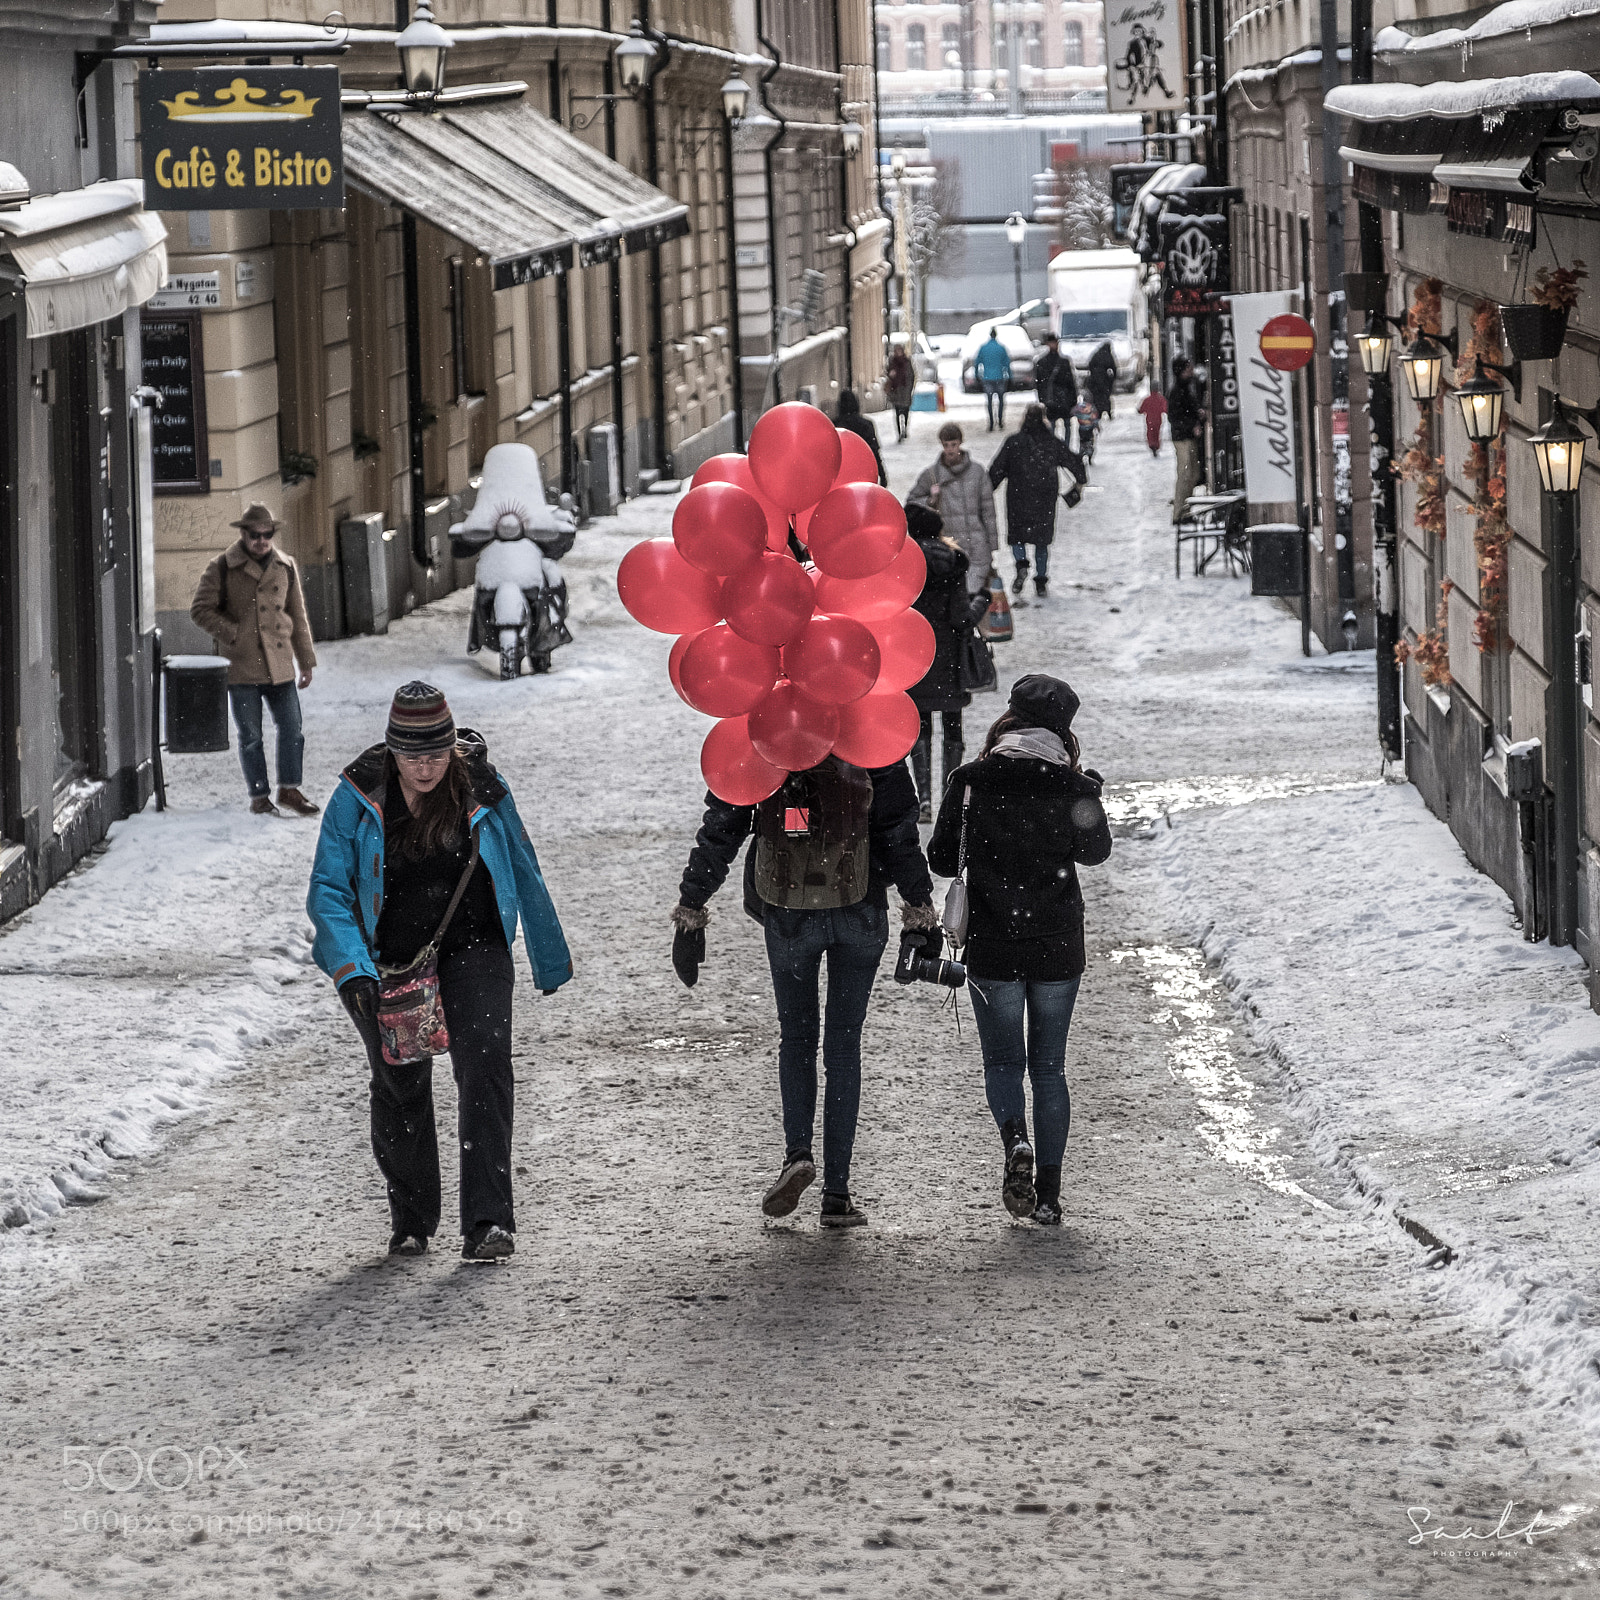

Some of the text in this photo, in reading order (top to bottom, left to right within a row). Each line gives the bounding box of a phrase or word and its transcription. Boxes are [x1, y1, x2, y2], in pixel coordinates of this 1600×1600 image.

[155, 146, 332, 188] Cafè & Bistro
[176, 278, 217, 291] Nygatan
[188, 293, 218, 305] 42 40
[141, 355, 187, 369] pen Daily
[1219, 314, 1238, 410] TATTOO
[162, 414, 186, 427] Quiz
[161, 443, 192, 456] Sports
